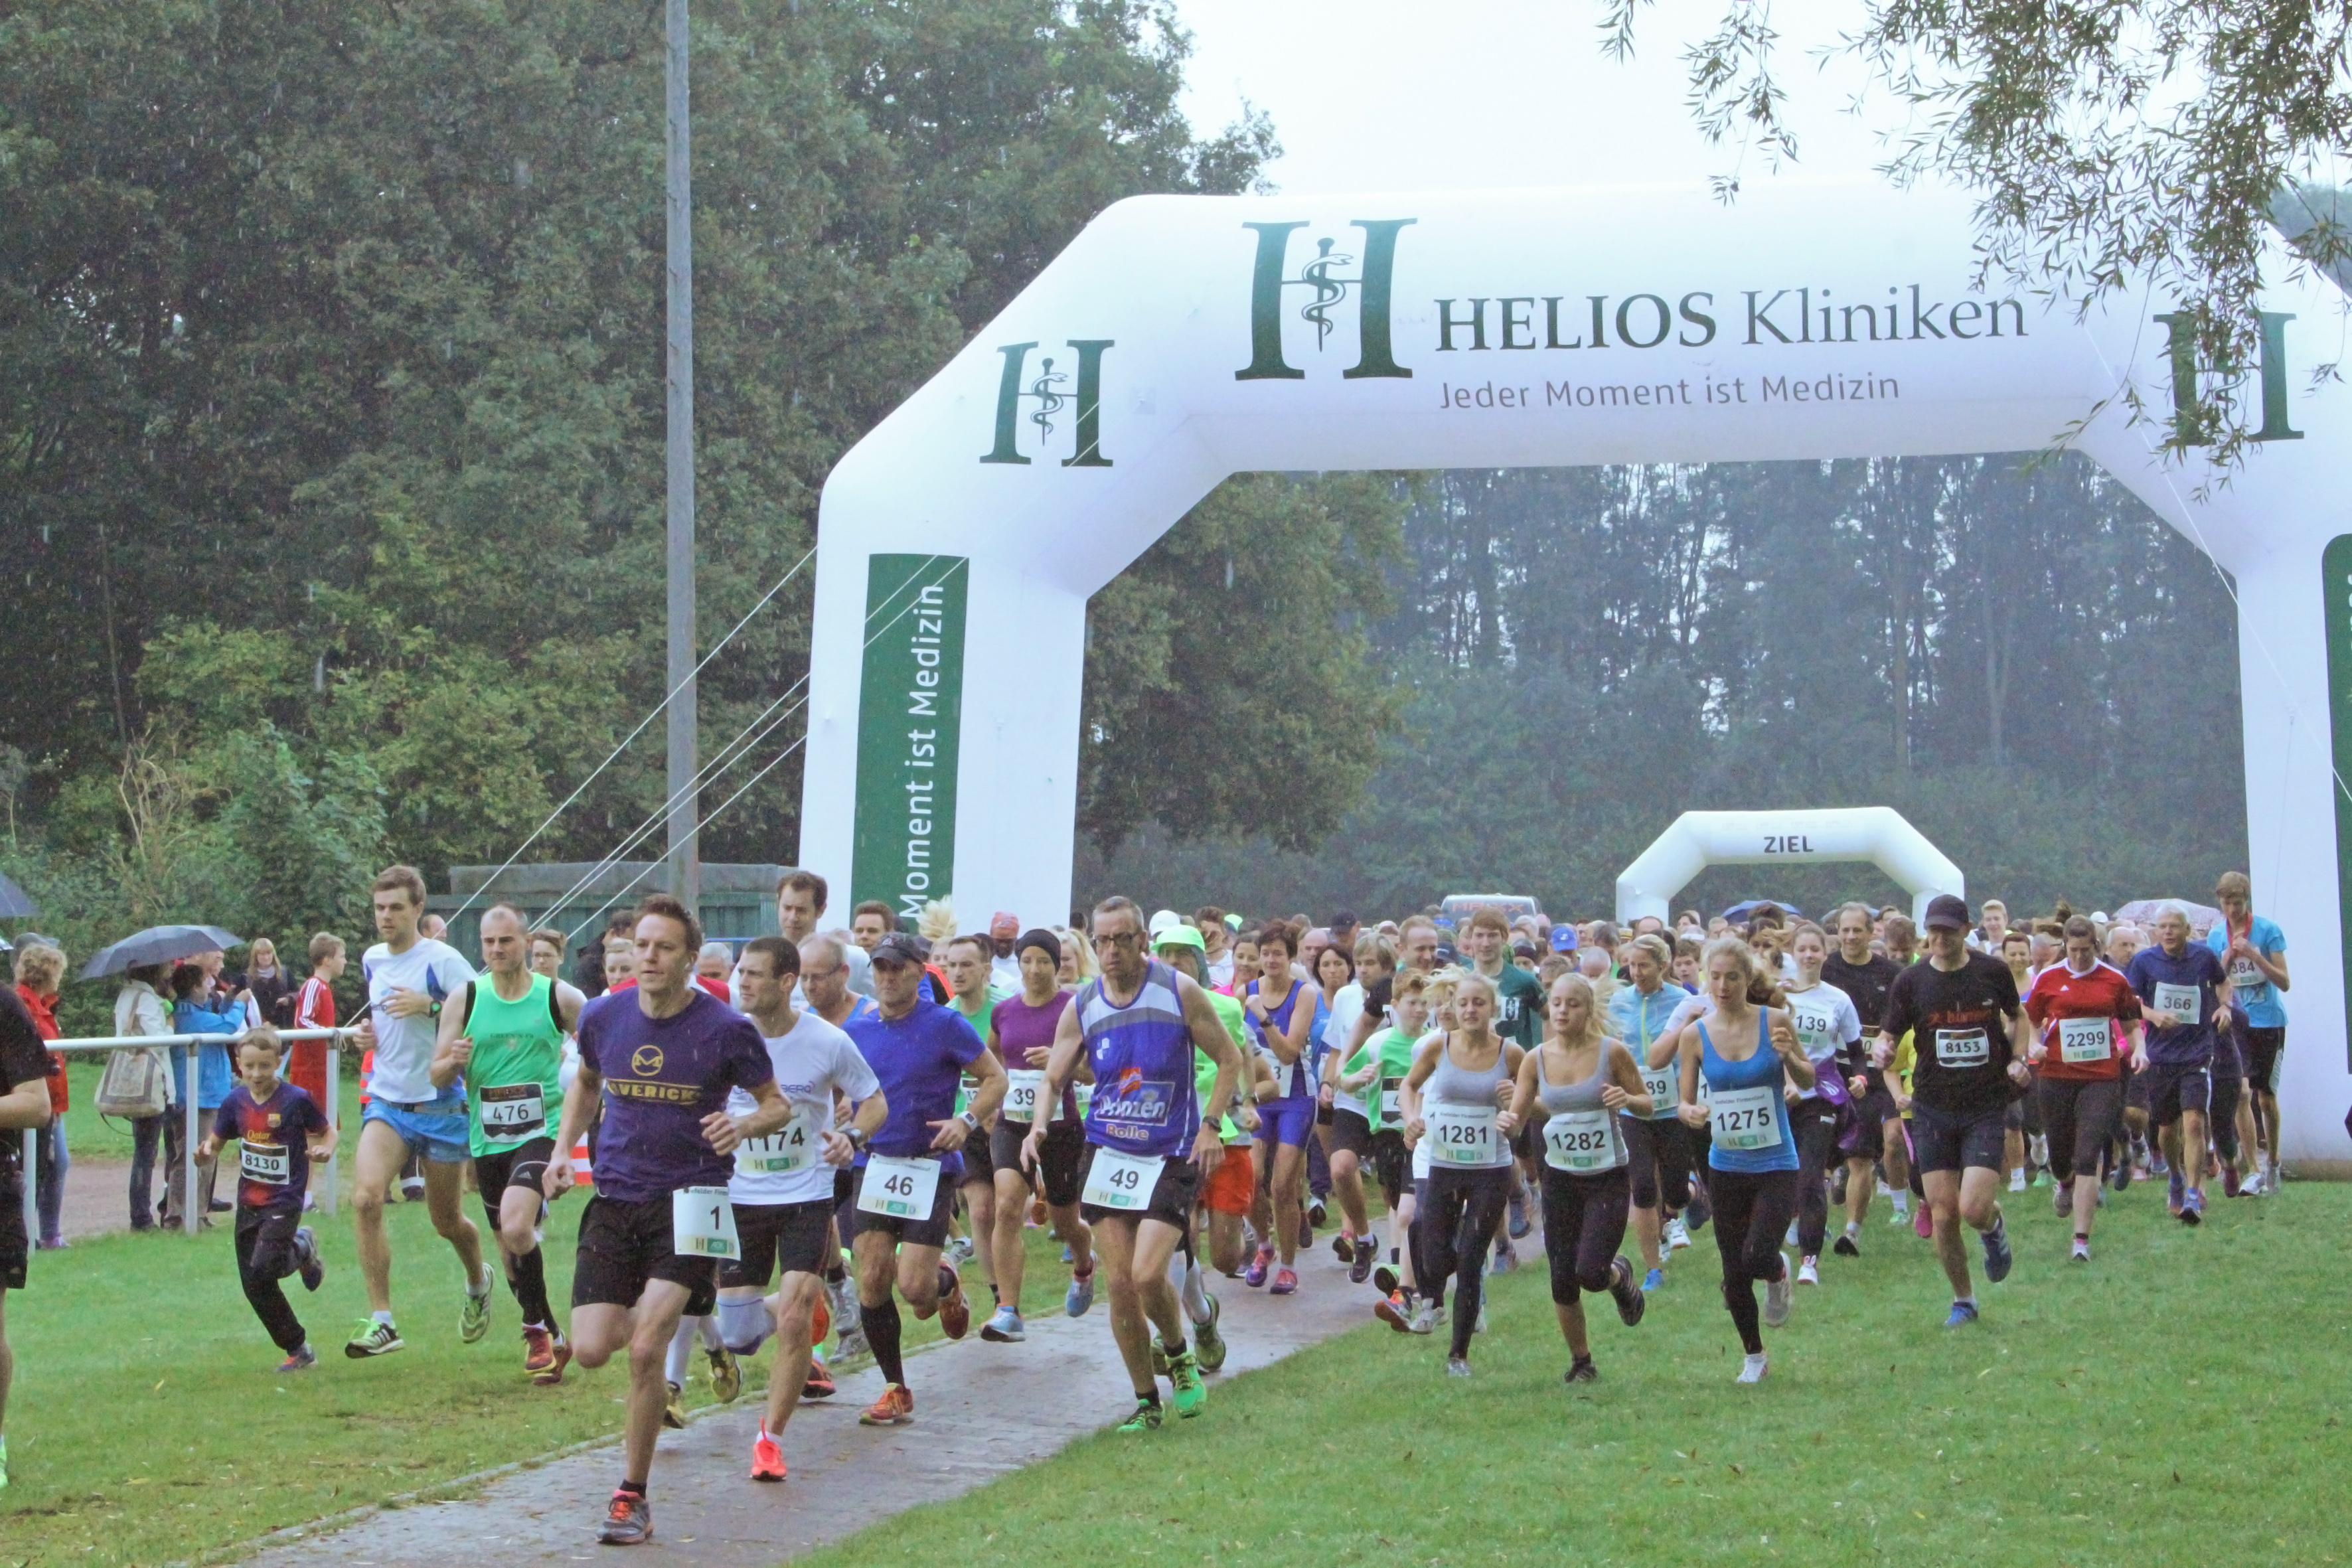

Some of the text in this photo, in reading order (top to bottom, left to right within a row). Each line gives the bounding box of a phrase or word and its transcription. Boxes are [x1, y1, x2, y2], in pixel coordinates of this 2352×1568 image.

[1434, 283, 2029, 352] HELIOS Kliniken
[1440, 372, 1900, 409] Jeder Moment ist Medizin
[899, 586, 943, 918] Moment ist Medizin
[1764, 835, 1814, 853] ZIEL
[2231, 961, 2256, 974] 384
[2164, 996, 2192, 1010] 366
[1796, 1014, 1826, 1032] 139
[1946, 1041, 1981, 1054] 8153
[2067, 1031, 2105, 1047] 2299
[1014, 1088, 1035, 1105] 39
[493, 1104, 529, 1122] 476
[1717, 1107, 1770, 1131] 1275
[247, 1129, 271, 1141] Qatar
[1106, 1123, 1148, 1140] Rolle
[1440, 1125, 1487, 1144] 1281
[1552, 1130, 1606, 1150] 1282
[245, 1154, 279, 1170] 8130
[884, 1174, 914, 1196] 46
[1109, 1168, 1139, 1190] 49
[710, 1206, 720, 1230] 1
